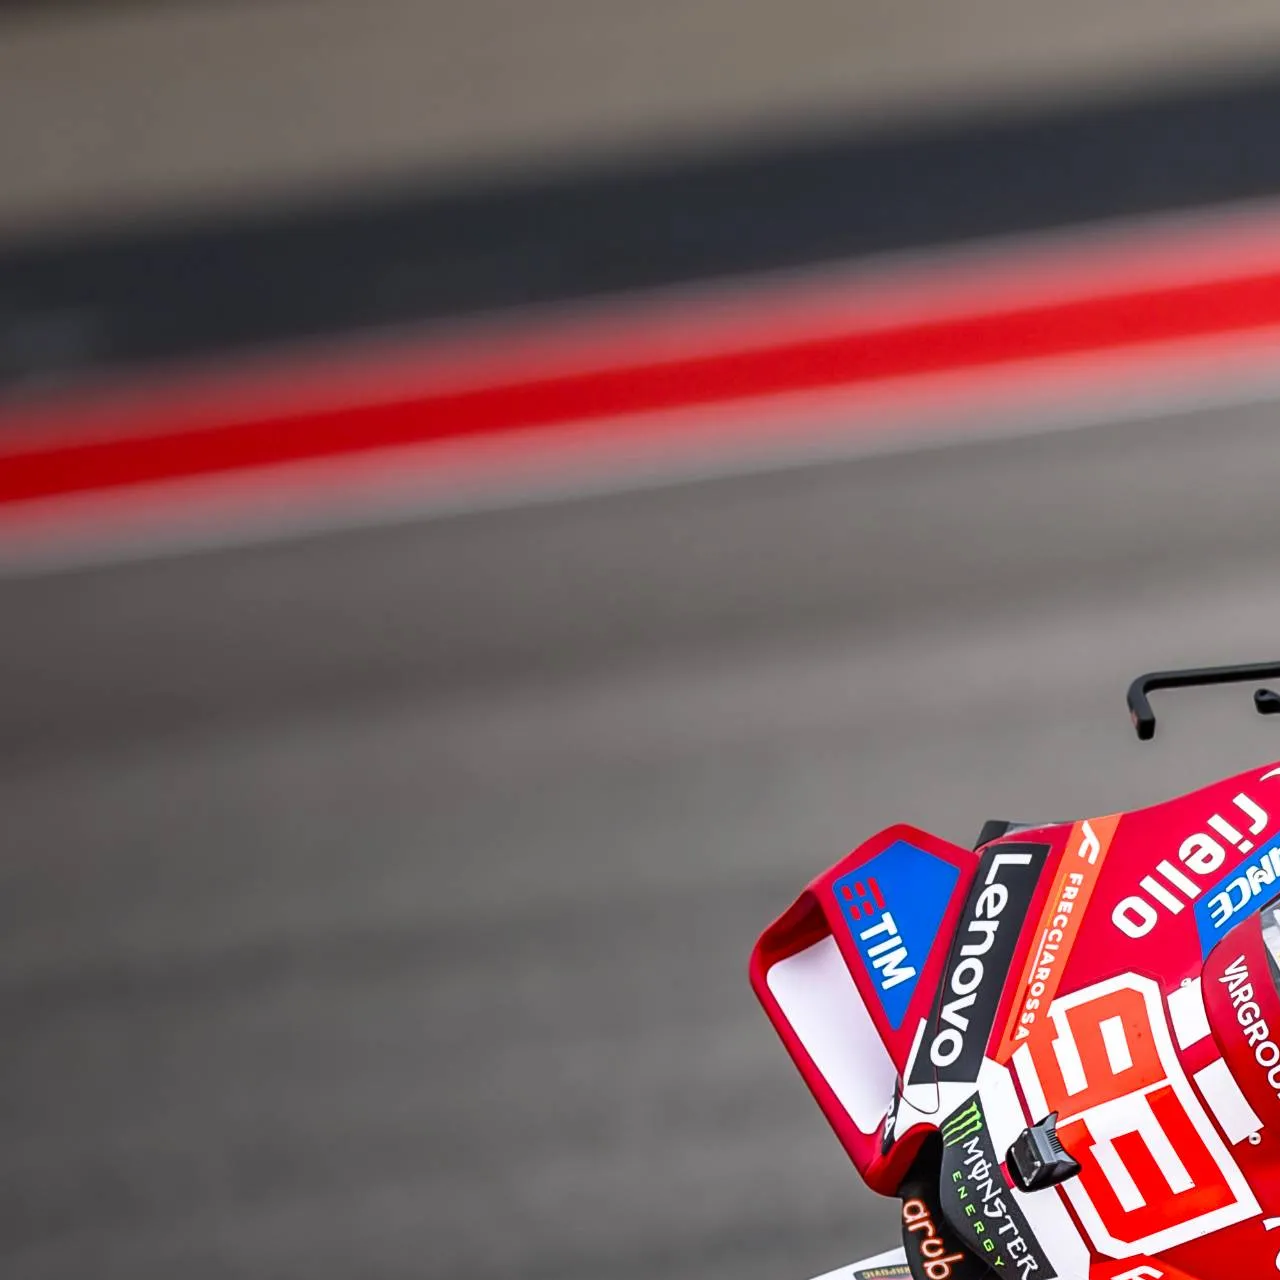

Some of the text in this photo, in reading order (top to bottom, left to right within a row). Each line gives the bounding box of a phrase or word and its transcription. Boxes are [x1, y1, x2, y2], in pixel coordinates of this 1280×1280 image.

[1111, 792, 1269, 939] riello
[860, 910, 916, 991] TIM
[928, 853, 1033, 1067] Lenovo
[1015, 871, 1084, 1041] FRECCIAROSSA
[1024, 988, 1242, 1246] 93
[951, 1171, 1006, 1268] ENERGY
